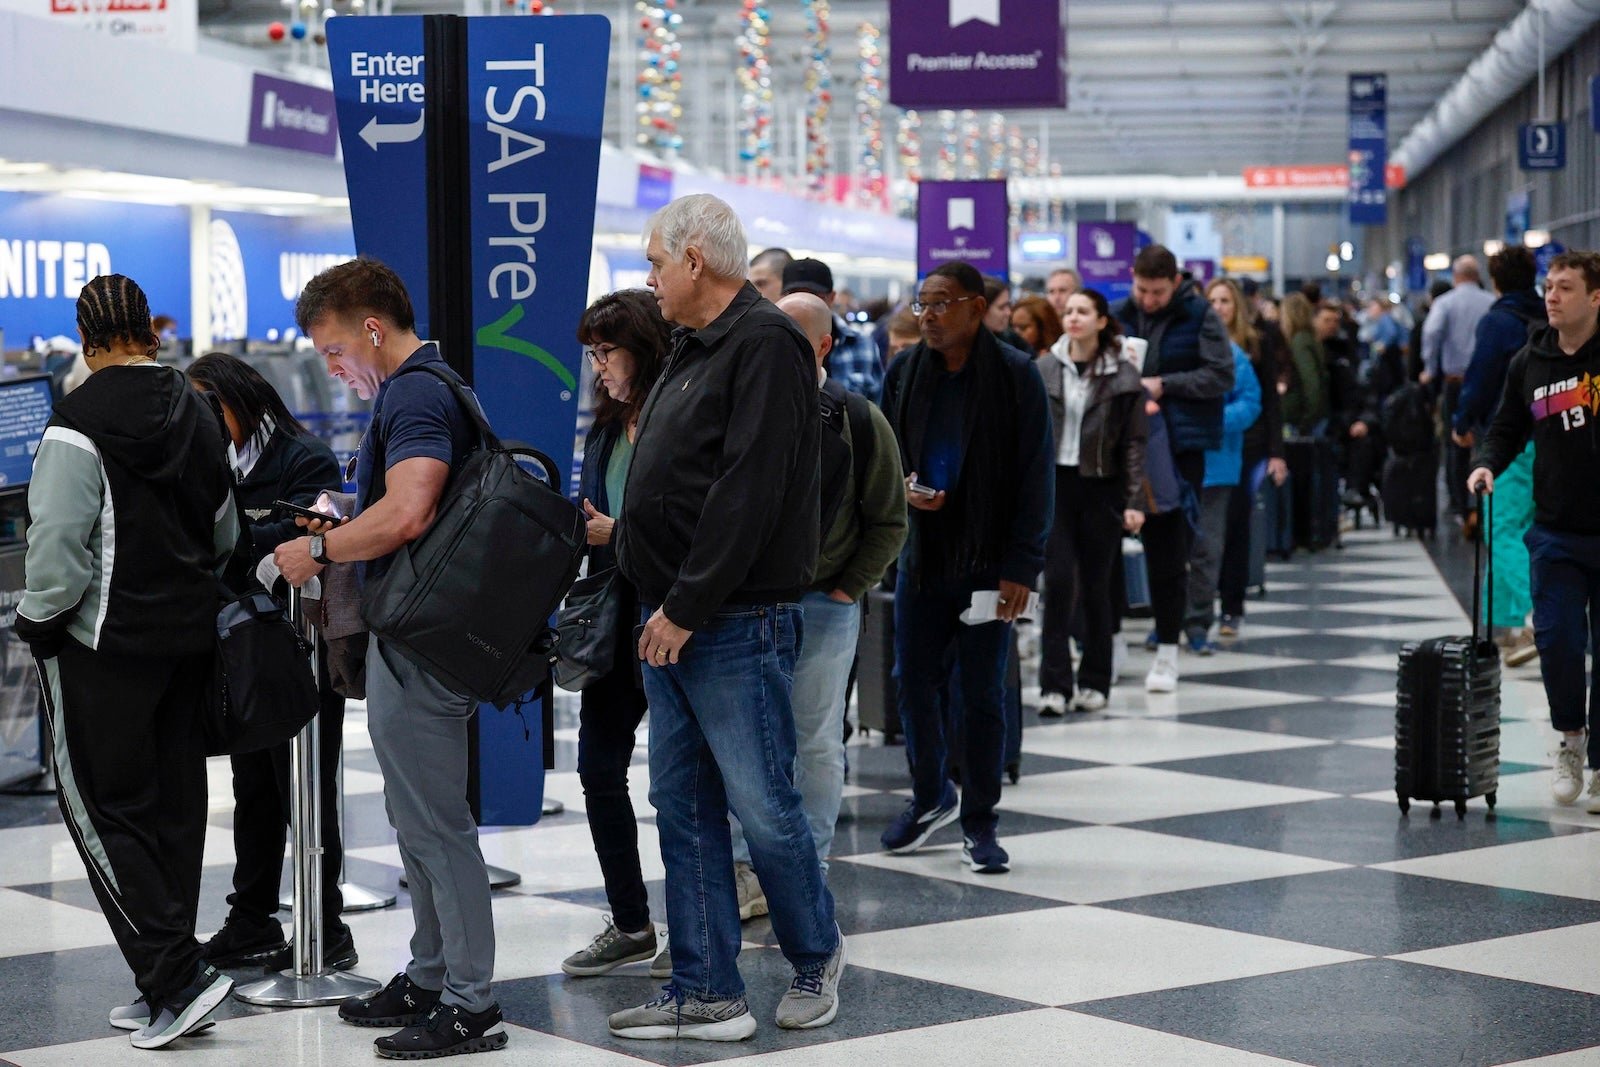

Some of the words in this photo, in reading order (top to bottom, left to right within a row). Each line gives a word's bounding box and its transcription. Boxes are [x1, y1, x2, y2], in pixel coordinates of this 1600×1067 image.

[351, 52, 424, 76] Enter
[907, 53, 972, 71] Premier
[973, 51, 1038, 69] Access
[360, 79, 425, 103] Here
[485, 43, 546, 173] TSA
[487, 193, 547, 300] Pre
[1561, 405, 1585, 431] 13
[465, 631, 503, 660] NOMATIC
